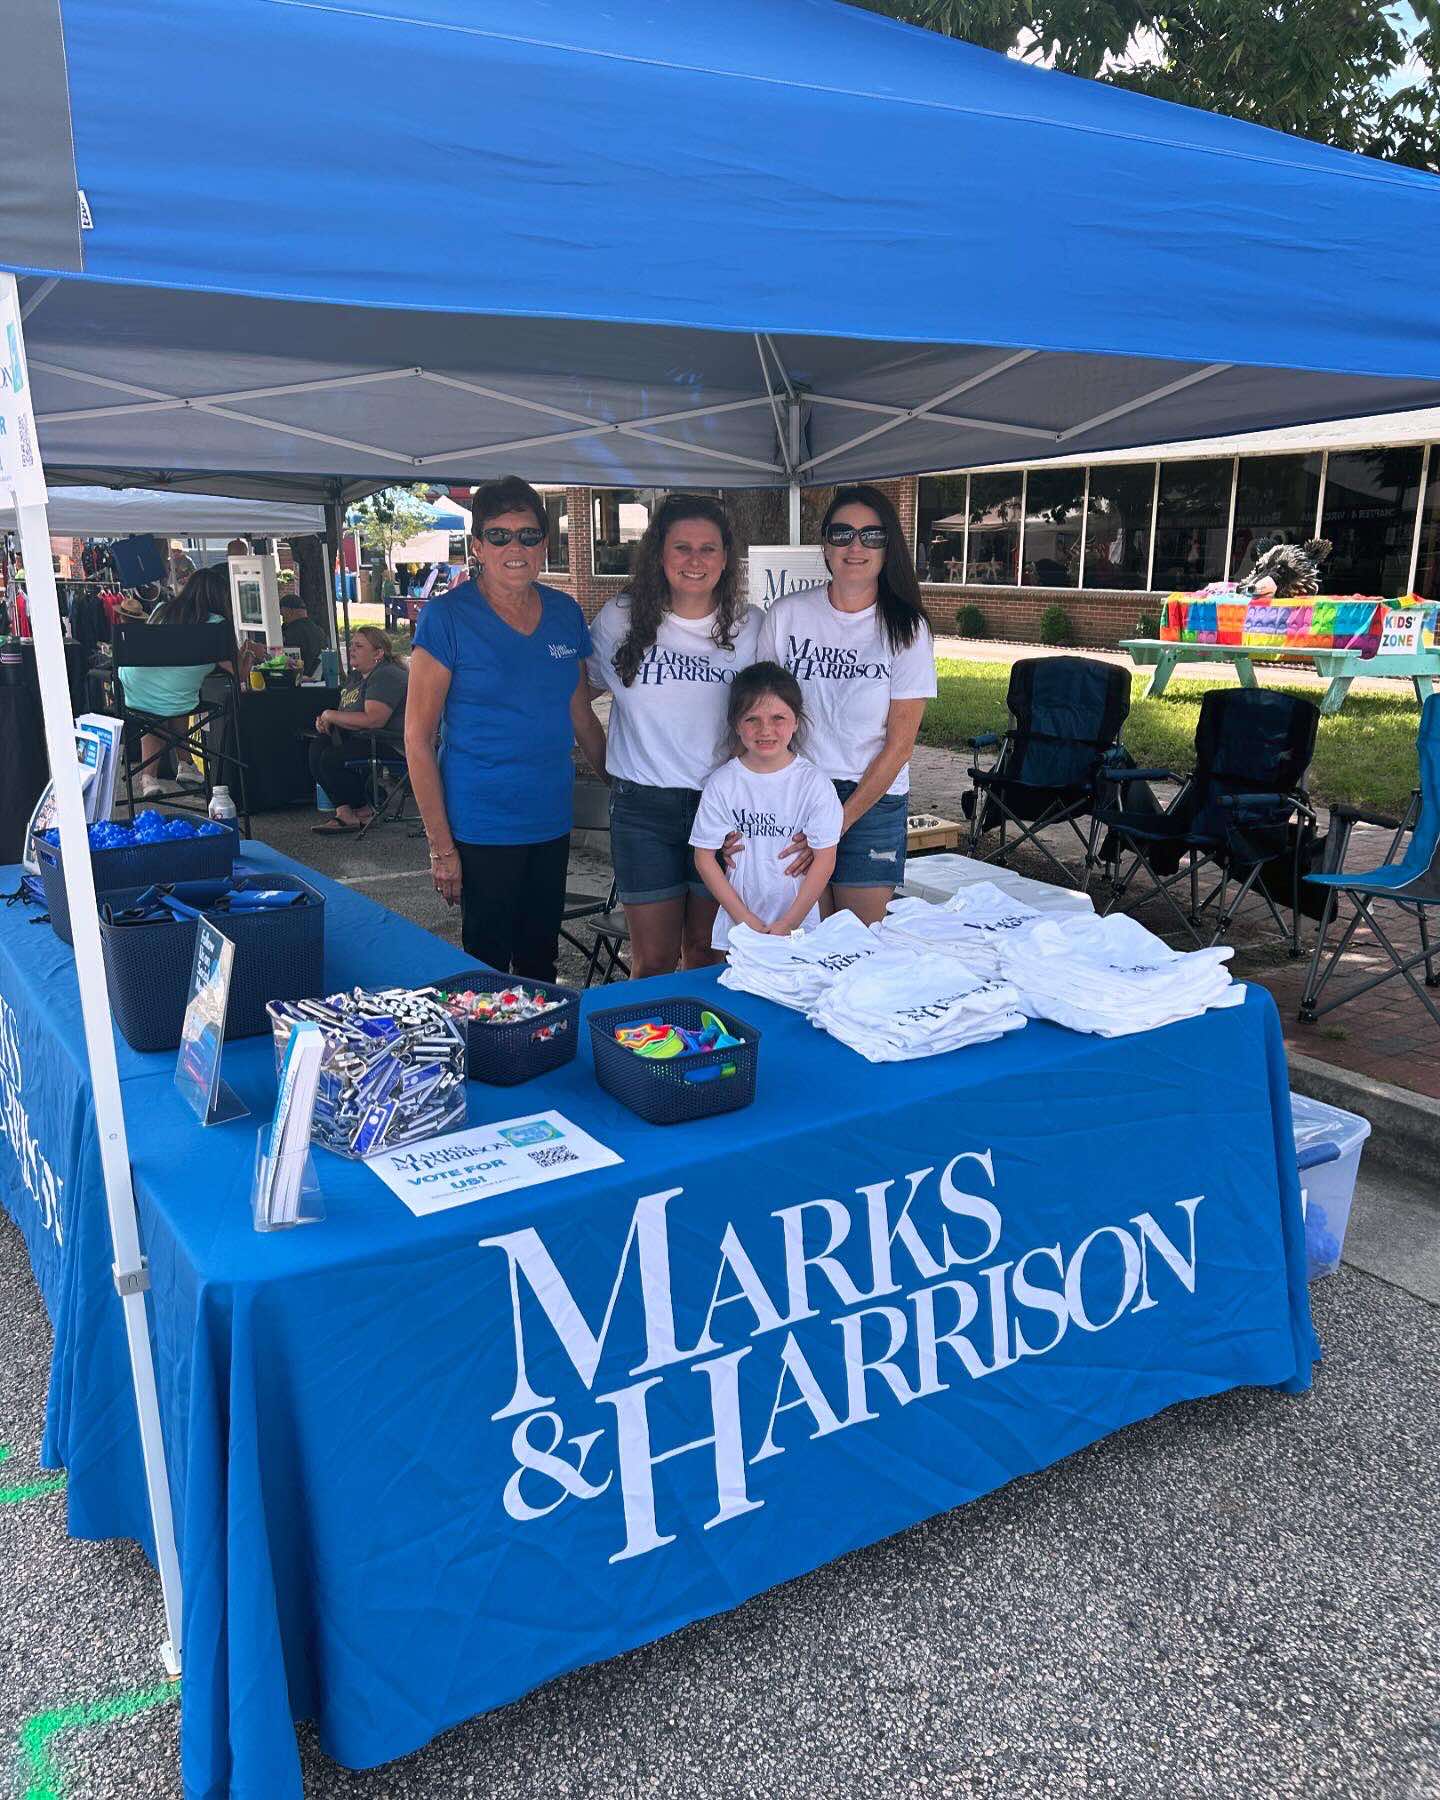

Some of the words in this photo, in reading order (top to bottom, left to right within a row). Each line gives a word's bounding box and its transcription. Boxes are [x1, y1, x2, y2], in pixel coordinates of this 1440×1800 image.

[1386, 616, 1416, 629] KIDS'
[786, 635, 857, 664] MARKS
[1382, 634, 1414, 647] ZONE
[640, 663, 738, 685] HARRISO
[391, 1144, 467, 1171] MARKS
[408, 1168, 462, 1186] VOTE
[463, 1159, 507, 1174] FOR
[478, 1148, 1002, 1421] MARKS
